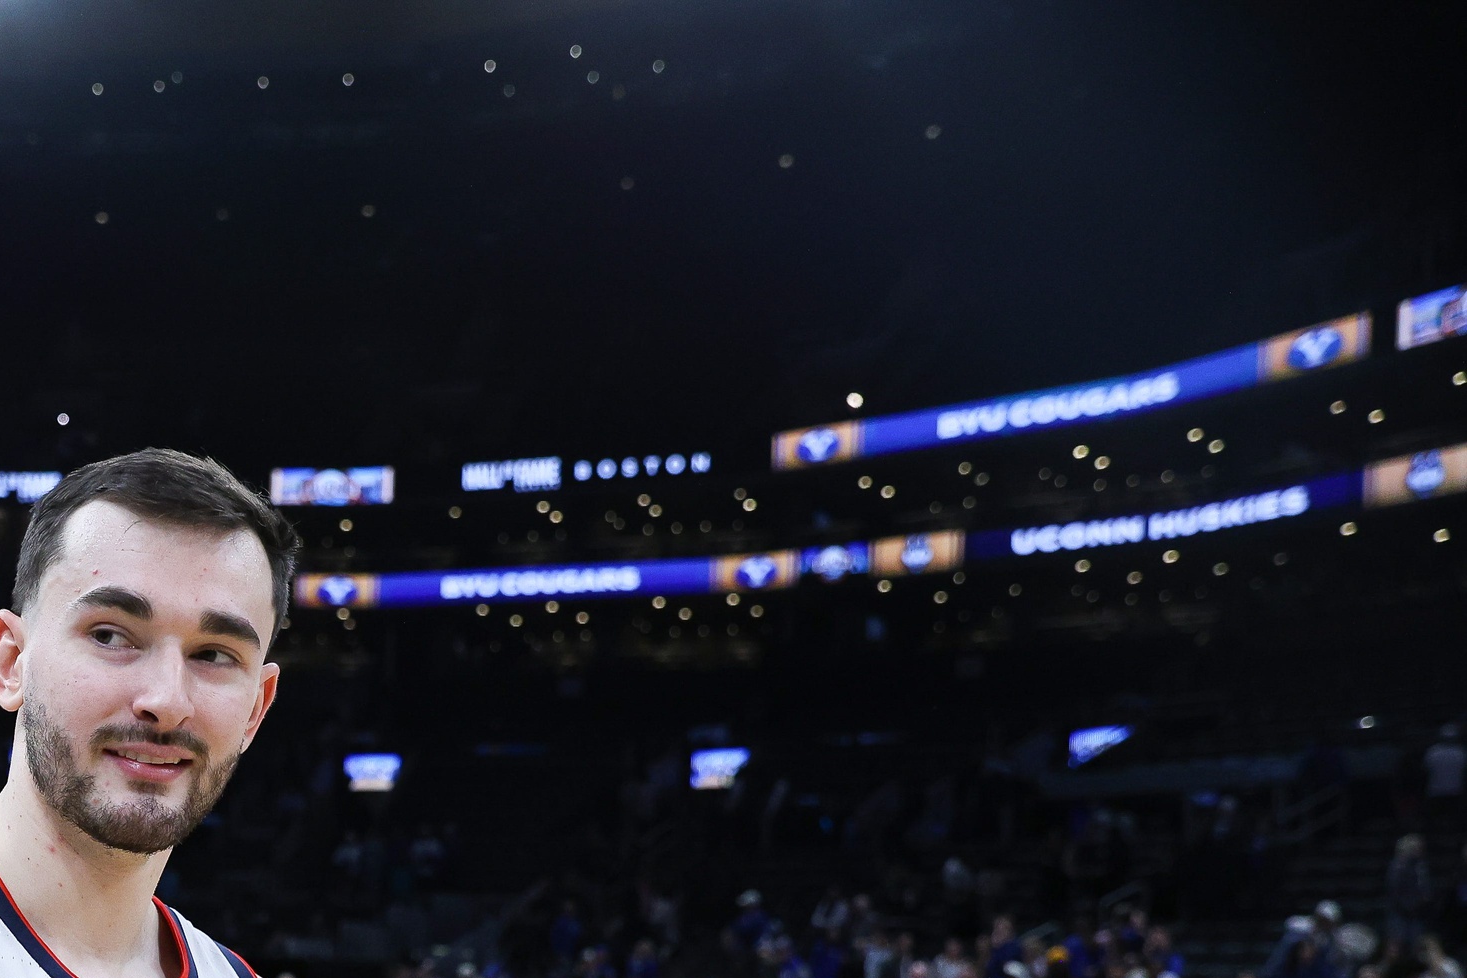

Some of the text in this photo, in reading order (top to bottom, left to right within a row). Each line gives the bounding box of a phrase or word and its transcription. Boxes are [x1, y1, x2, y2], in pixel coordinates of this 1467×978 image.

[937, 371, 1180, 440] BYU COUGARS
[1011, 485, 1309, 556] UCONN HUSKIES
[440, 566, 641, 599] BYU COUGARS
